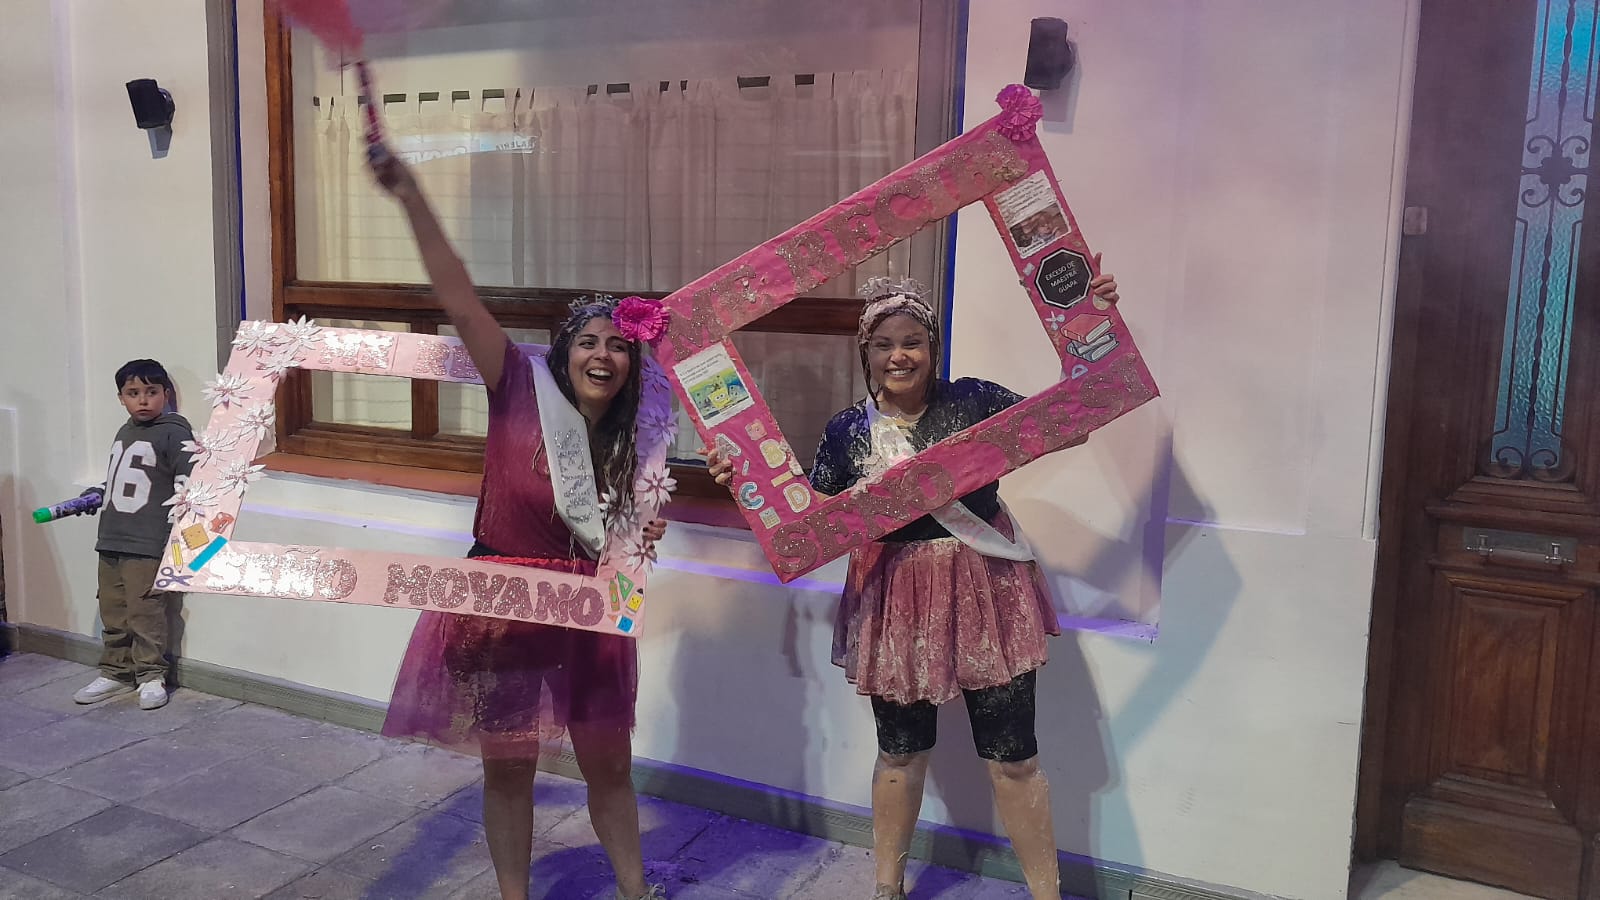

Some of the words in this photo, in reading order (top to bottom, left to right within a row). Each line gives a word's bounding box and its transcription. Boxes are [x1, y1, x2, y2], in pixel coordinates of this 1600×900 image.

[1045, 266, 1067, 281] EXCESO
[1066, 261, 1076, 269] DE
[1050, 270, 1077, 287] MAESTRA
[1058, 280, 1078, 293] GUAPA
[975, 352, 1151, 470] YESI
[383, 561, 605, 628] MOYANO
